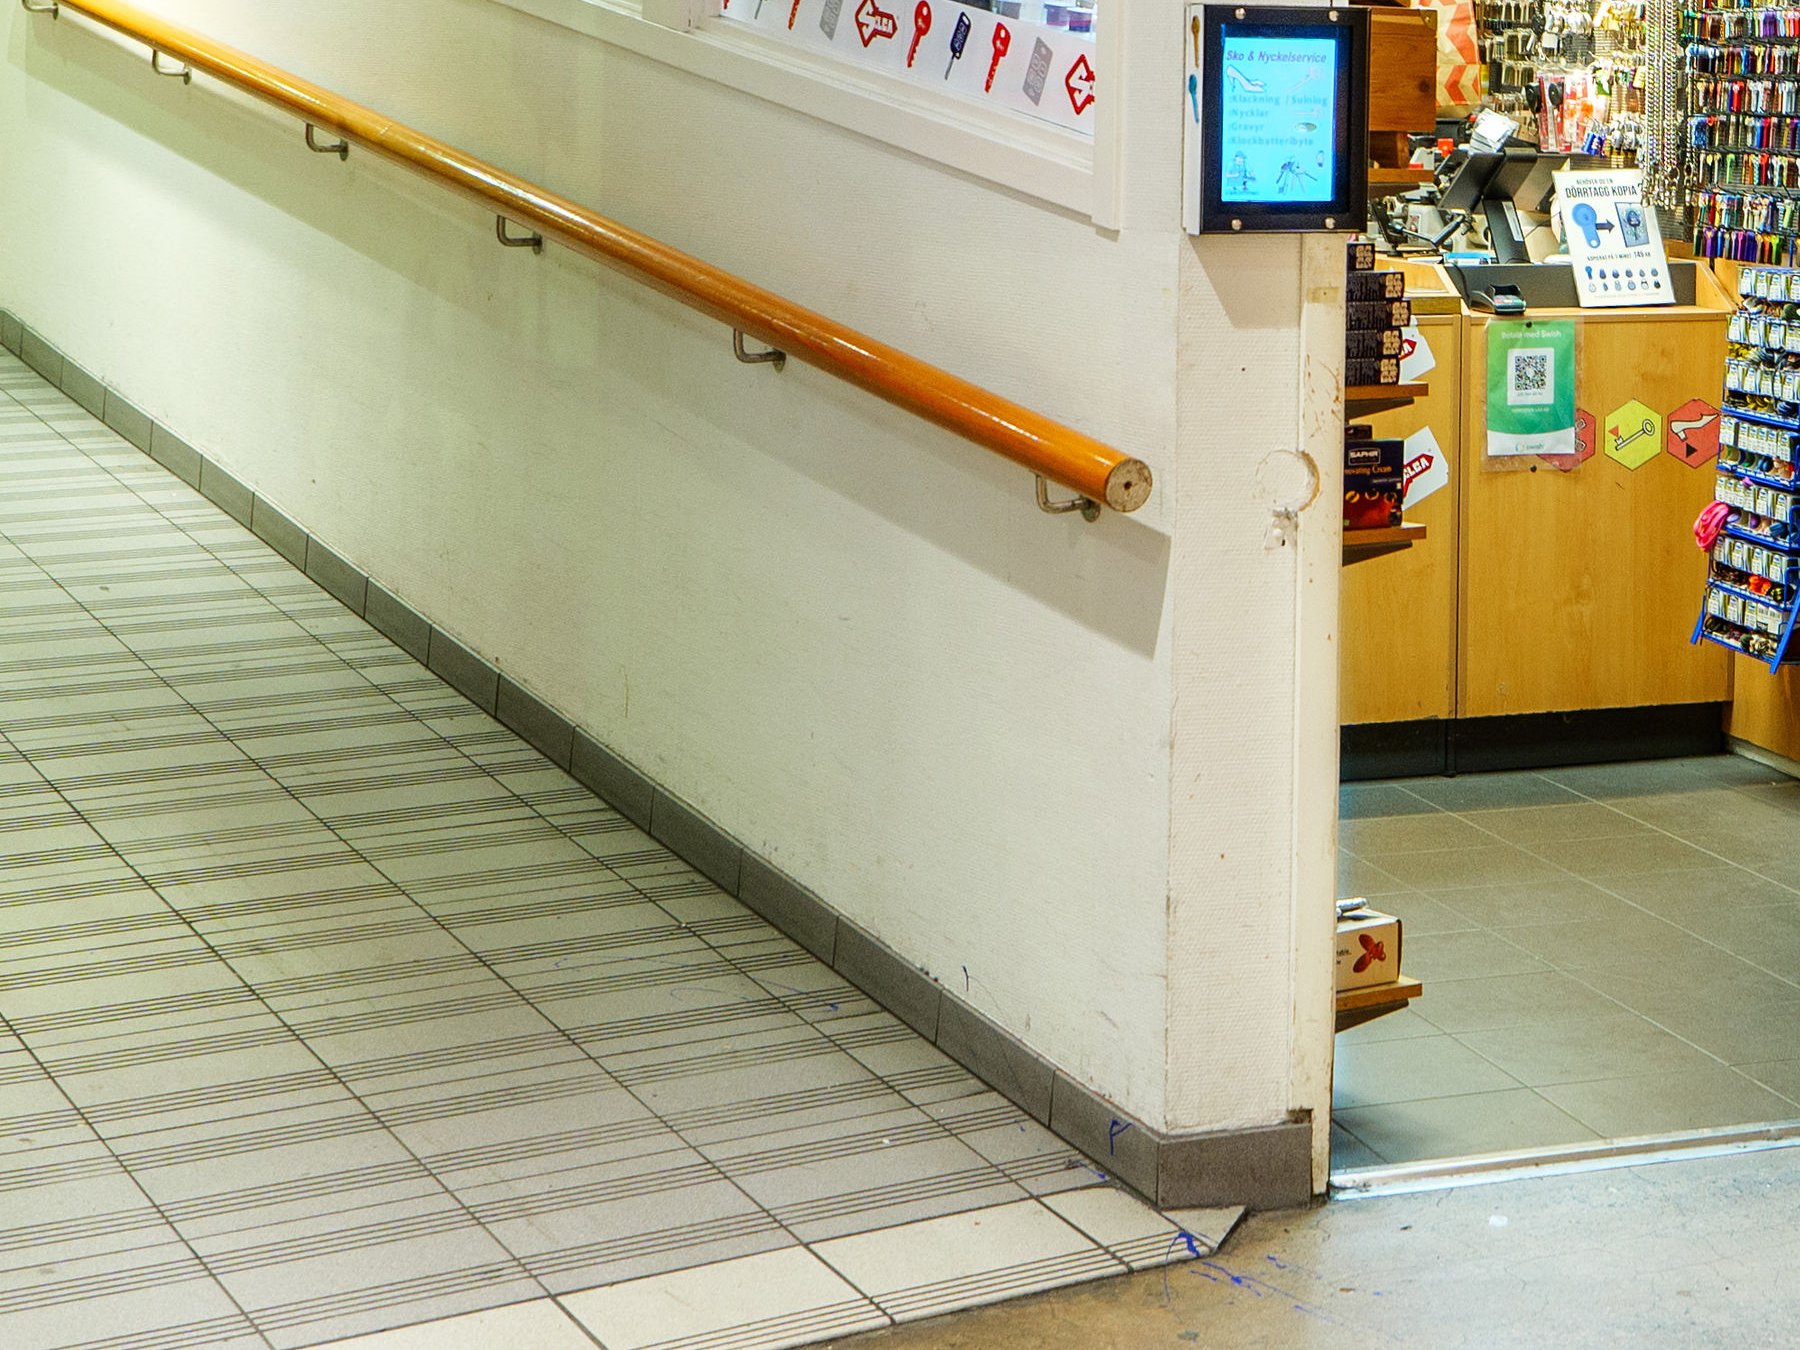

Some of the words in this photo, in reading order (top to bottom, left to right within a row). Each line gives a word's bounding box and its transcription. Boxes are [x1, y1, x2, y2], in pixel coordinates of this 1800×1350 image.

[1226, 50, 1244, 62] Sko
[1258, 50, 1327, 65] Nyckelservice
[1565, 186, 1611, 198] DÖRRTAGG
[1611, 185, 1638, 197] KOPIA
